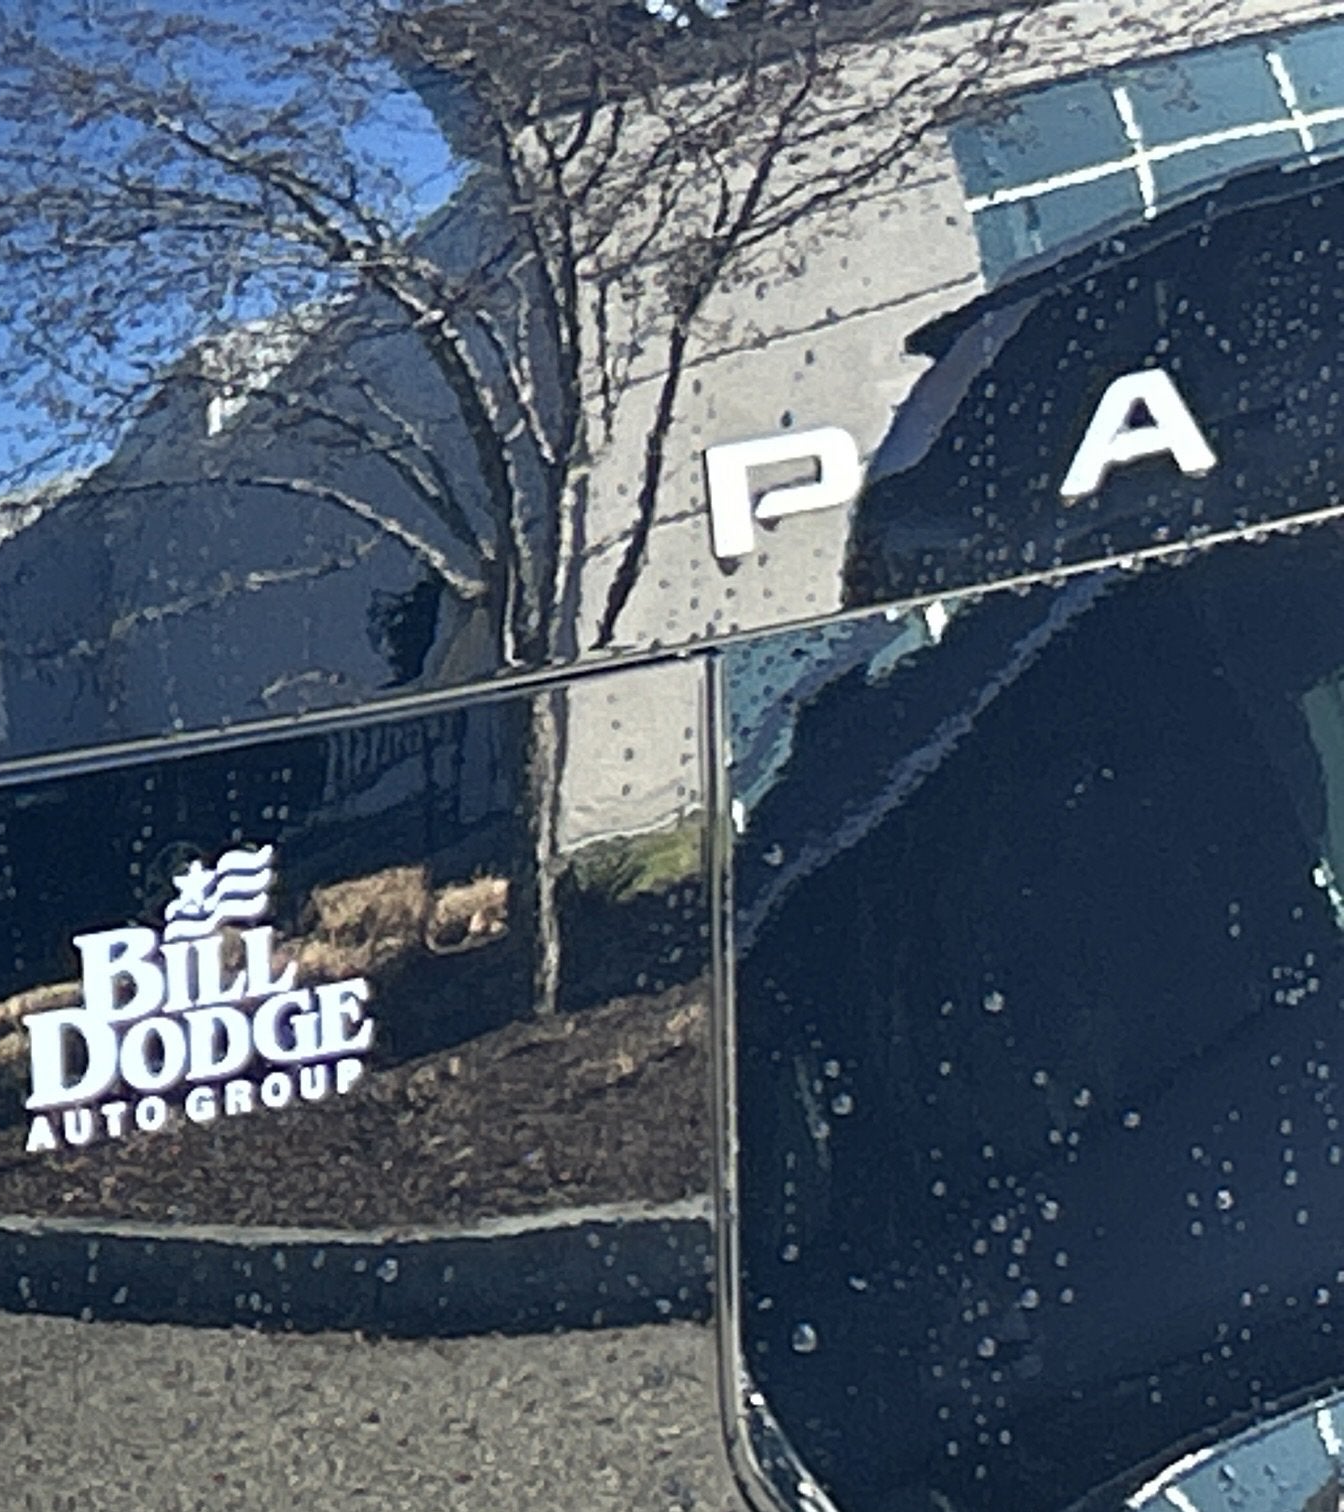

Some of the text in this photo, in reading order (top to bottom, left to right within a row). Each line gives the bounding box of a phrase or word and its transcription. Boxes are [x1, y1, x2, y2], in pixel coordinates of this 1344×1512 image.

[73, 926, 298, 1023] BILL
[23, 978, 374, 1109] DODGE
[25, 1058, 364, 1152] AUTO GROUP
